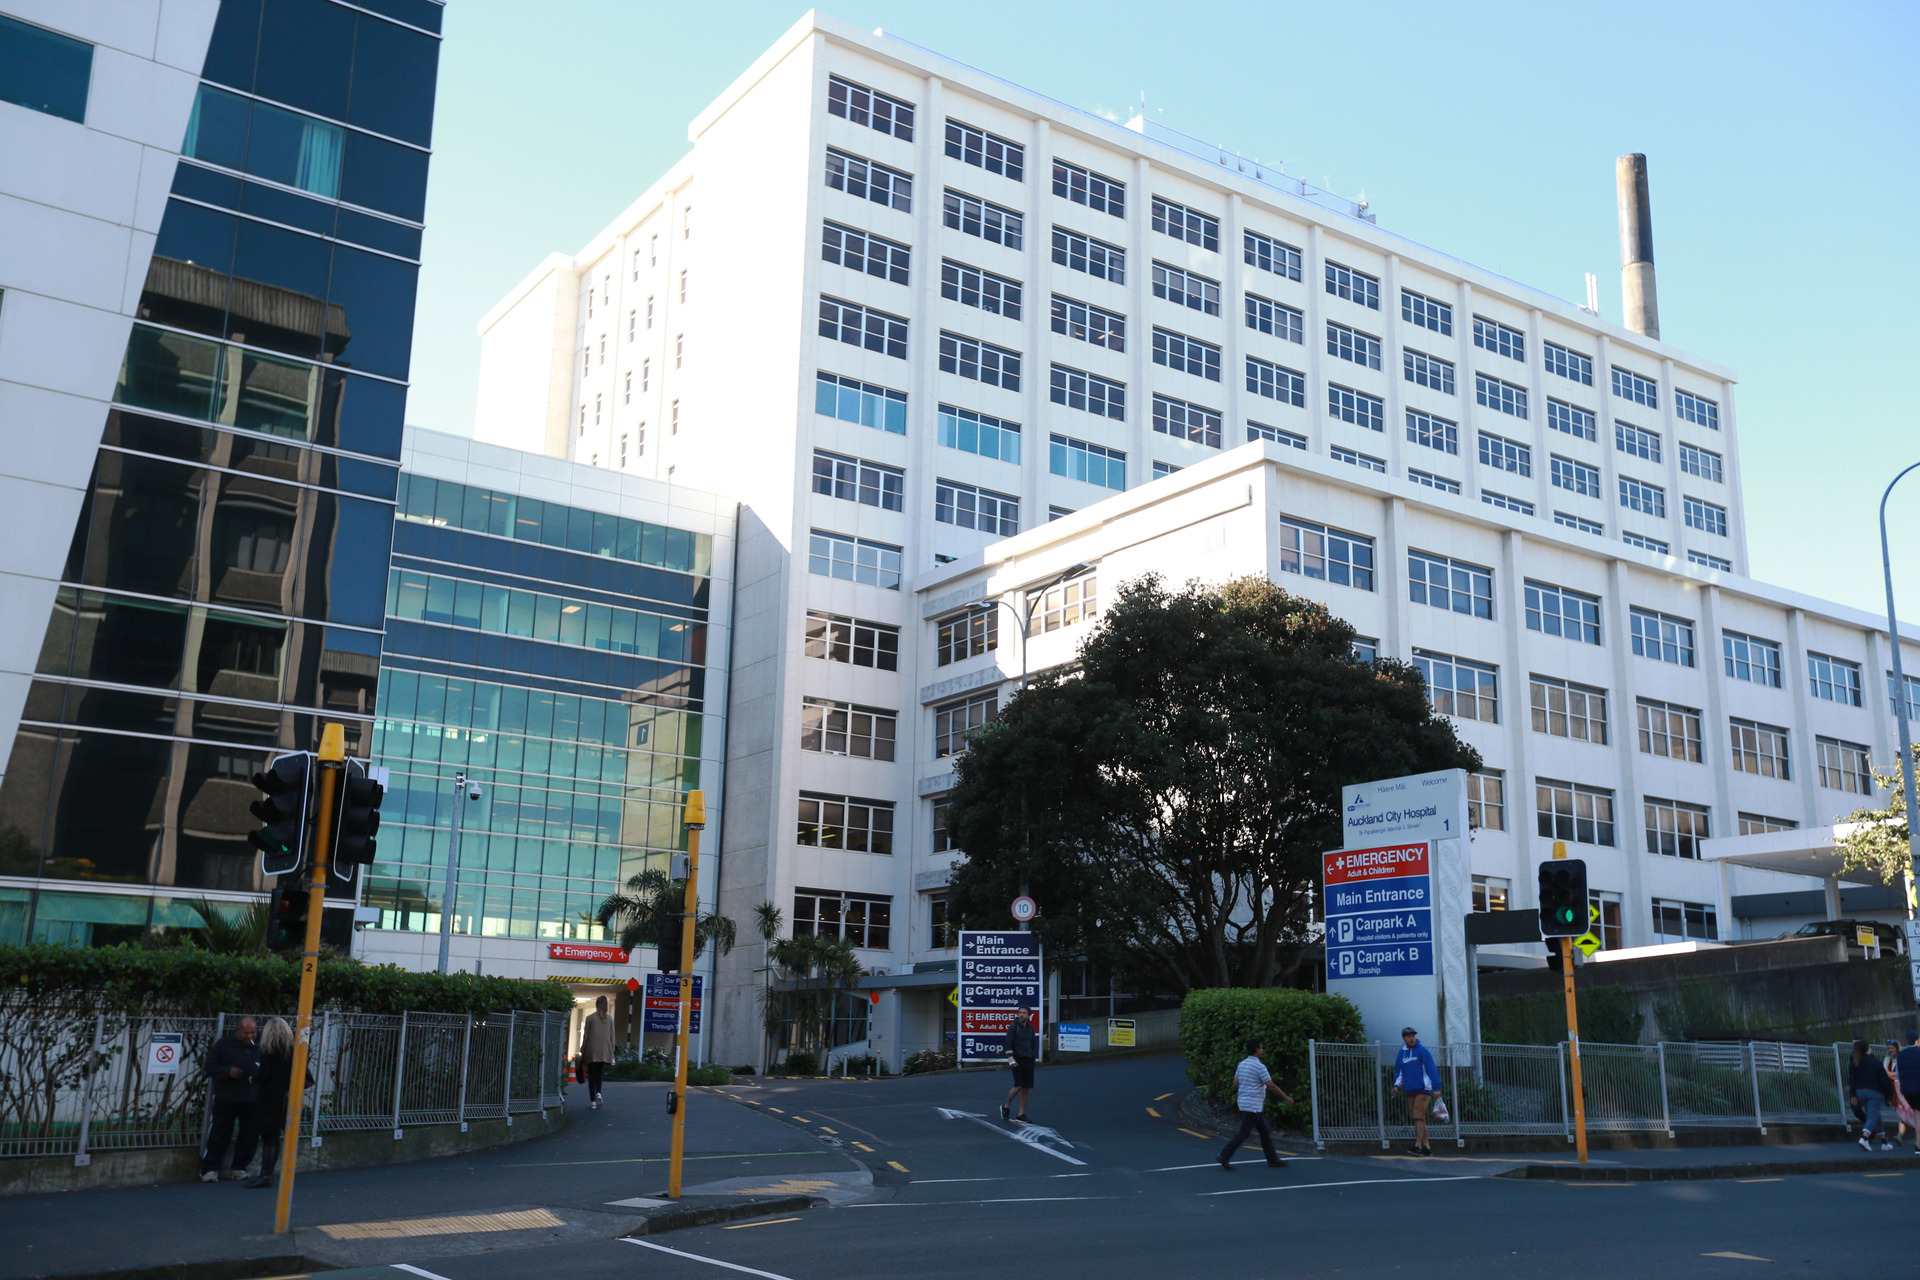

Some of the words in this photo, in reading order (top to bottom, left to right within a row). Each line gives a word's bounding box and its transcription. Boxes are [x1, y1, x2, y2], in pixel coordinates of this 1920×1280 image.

[1421, 777, 1448, 787] Welcome
[1347, 813, 1384, 828] Auckland
[1385, 810, 1402, 823] City
[1404, 805, 1437, 820] Hospital
[1443, 818, 1449, 831] 1
[1346, 847, 1424, 869] EMERGENCY
[1347, 869, 1362, 878] Adult
[1368, 866, 1395, 875] Children
[1336, 891, 1362, 907] Main
[1365, 888, 1424, 903] Entrance
[1018, 904, 1029, 913] 10
[1355, 915, 1403, 932] Carpark
[1406, 914, 1417, 927] A
[976, 935, 1004, 945] Main
[1356, 934, 1374, 942] Hospital
[1396, 932, 1416, 940] patients
[1417, 931, 1429, 939] only
[564, 946, 614, 961] Emergency
[976, 945, 1030, 954] Entrance
[1357, 948, 1405, 965] Carpark
[1409, 947, 1419, 961] B
[305, 963, 313, 972] 2
[975, 963, 1023, 975] Carpark
[1026, 964, 1036, 973] A
[1358, 967, 1381, 975] Starship
[682, 978, 689, 987] 3
[975, 986, 1023, 998] Carpark
[1026, 986, 1035, 996] B
[652, 1011, 675, 1019] Starship
[975, 1013, 1035, 1021] EMERGEY
[651, 1023, 675, 1031] Through
[975, 1042, 1004, 1054] Drop
